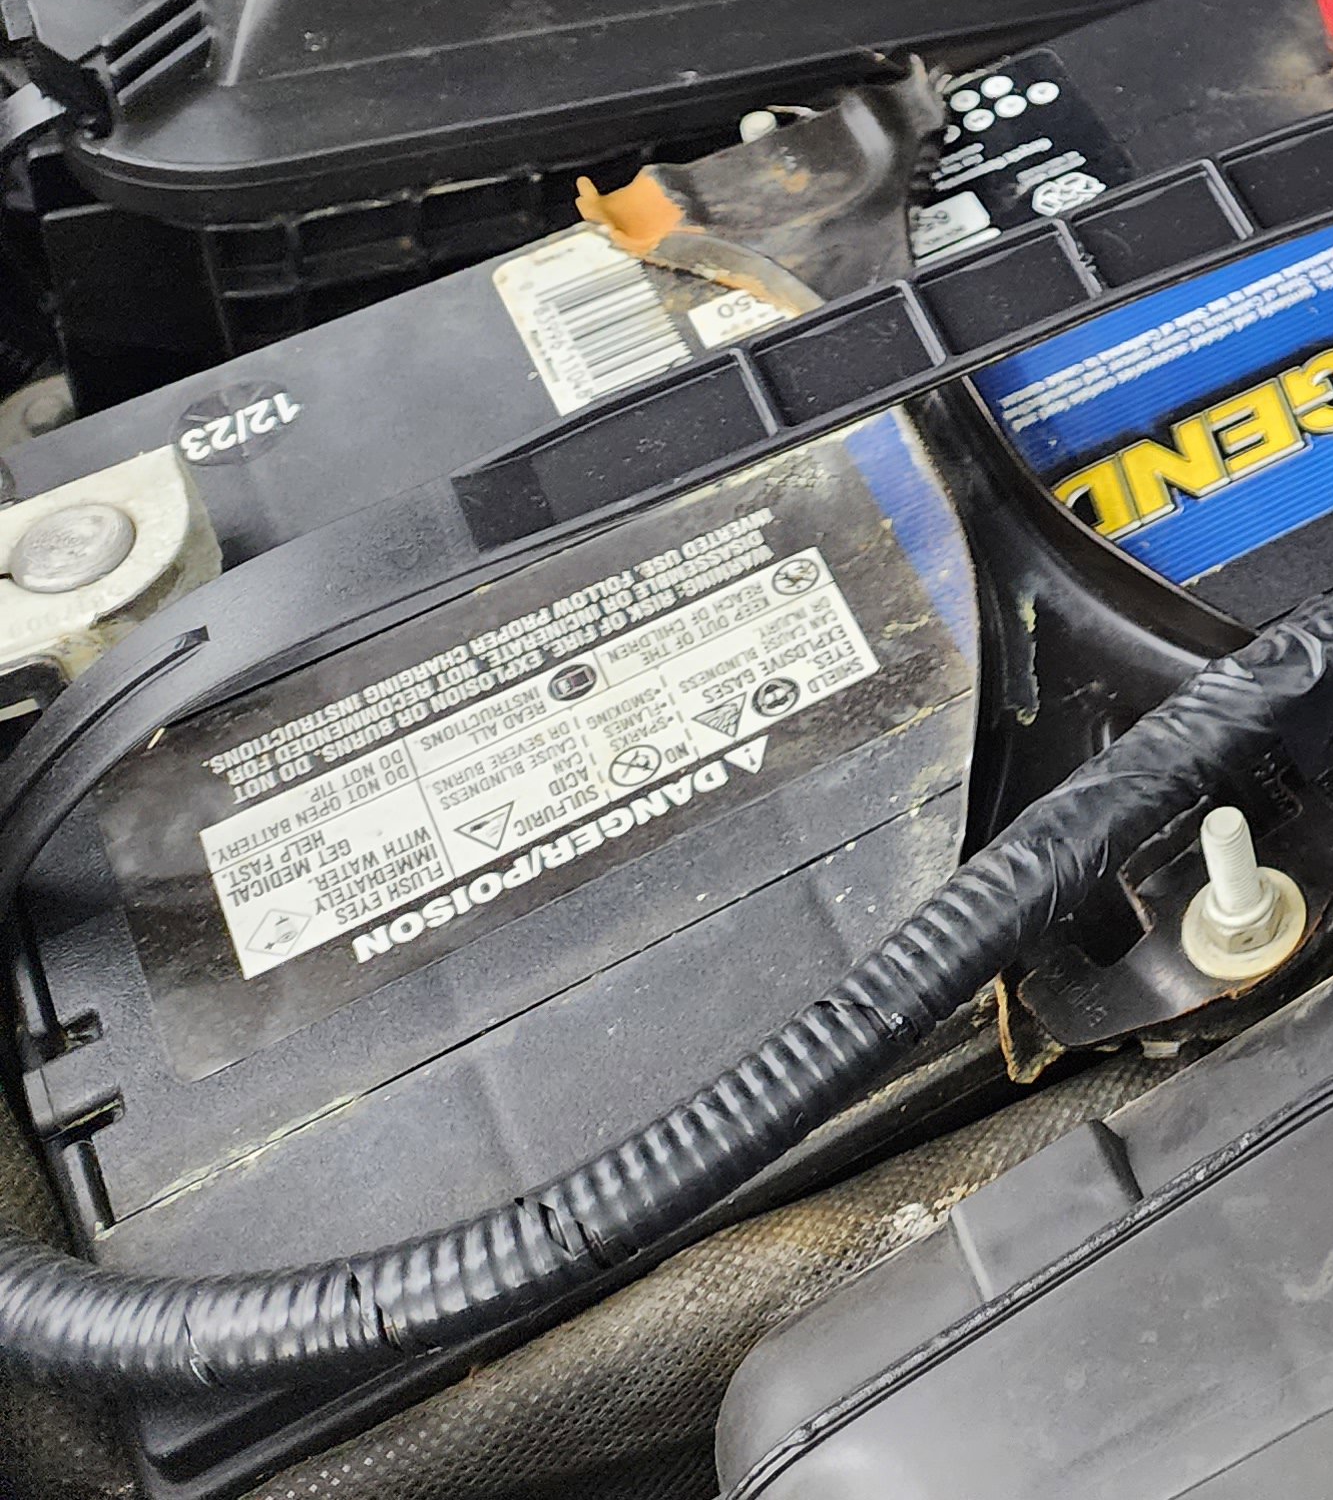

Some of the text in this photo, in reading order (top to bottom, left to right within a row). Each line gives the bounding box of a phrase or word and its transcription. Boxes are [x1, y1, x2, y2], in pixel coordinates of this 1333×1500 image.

[178, 389, 303, 464] 12/23
[467, 606, 552, 658] PROPER
[359, 641, 471, 706] CHARGING
[427, 647, 545, 714] EXPLOSION
[431, 656, 480, 692] NOT
[804, 654, 866, 695] SHIELD
[199, 690, 362, 780] INSTRUCTIONS.
[271, 677, 434, 766] RECOMMENDED
[395, 699, 430, 729] OR
[467, 699, 547, 747] READ ALL
[223, 751, 273, 788] FOR
[277, 753, 312, 783] DO
[338, 760, 376, 789] NOT
[377, 747, 403, 771] DO
[437, 734, 577, 812] CAUSE BLINDNESS
[485, 731, 546, 770] SEVERE
[550, 750, 584, 776] CAN
[661, 740, 690, 766] NO
[227, 768, 278, 806] NOT
[546, 764, 590, 797] ACID
[209, 763, 409, 866] DO NOT OPEN BATTERY.
[510, 782, 600, 838] SULFURIC
[220, 828, 326, 891] HELP FAST.
[225, 836, 352, 910] GET MEDICAL
[306, 824, 431, 896] WITH WATER.
[311, 841, 438, 915] IMMEDIATELY
[348, 755, 730, 966] DANGER/POISON
[332, 859, 445, 927] FLUSH EYES
